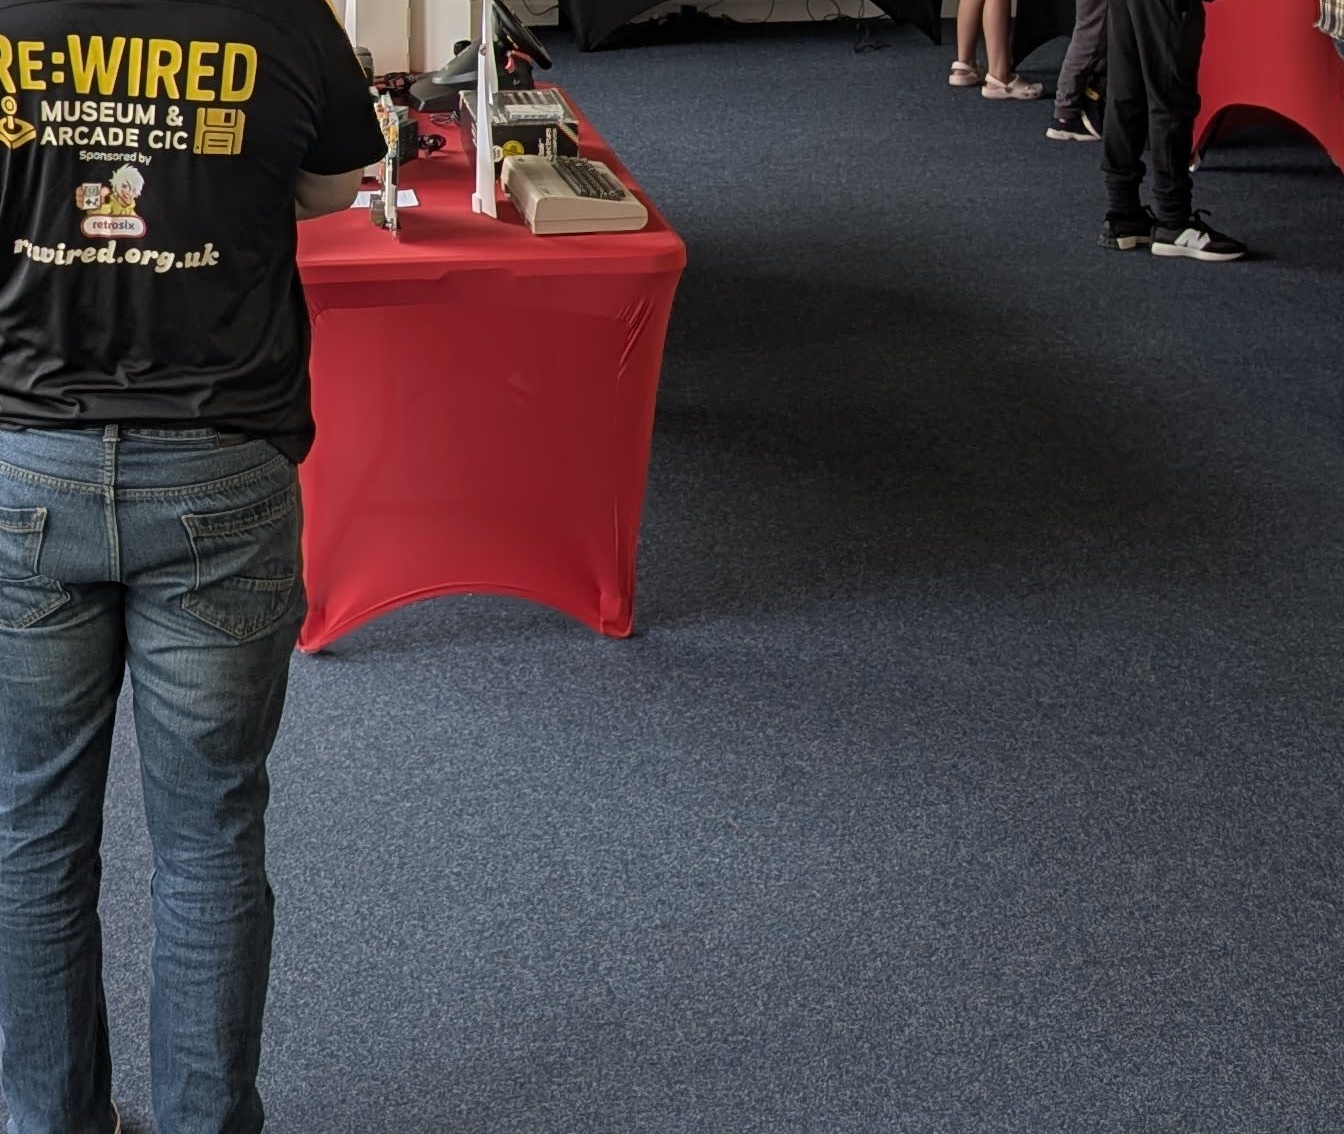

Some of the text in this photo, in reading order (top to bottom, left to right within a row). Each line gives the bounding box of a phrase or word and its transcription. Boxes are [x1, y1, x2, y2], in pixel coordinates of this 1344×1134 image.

[40, 100, 185, 127] MUSEUM &
[39, 125, 189, 150] ARCADE CIC
[79, 150, 153, 166] Sponsored by
[92, 219, 136, 231] retrosix
